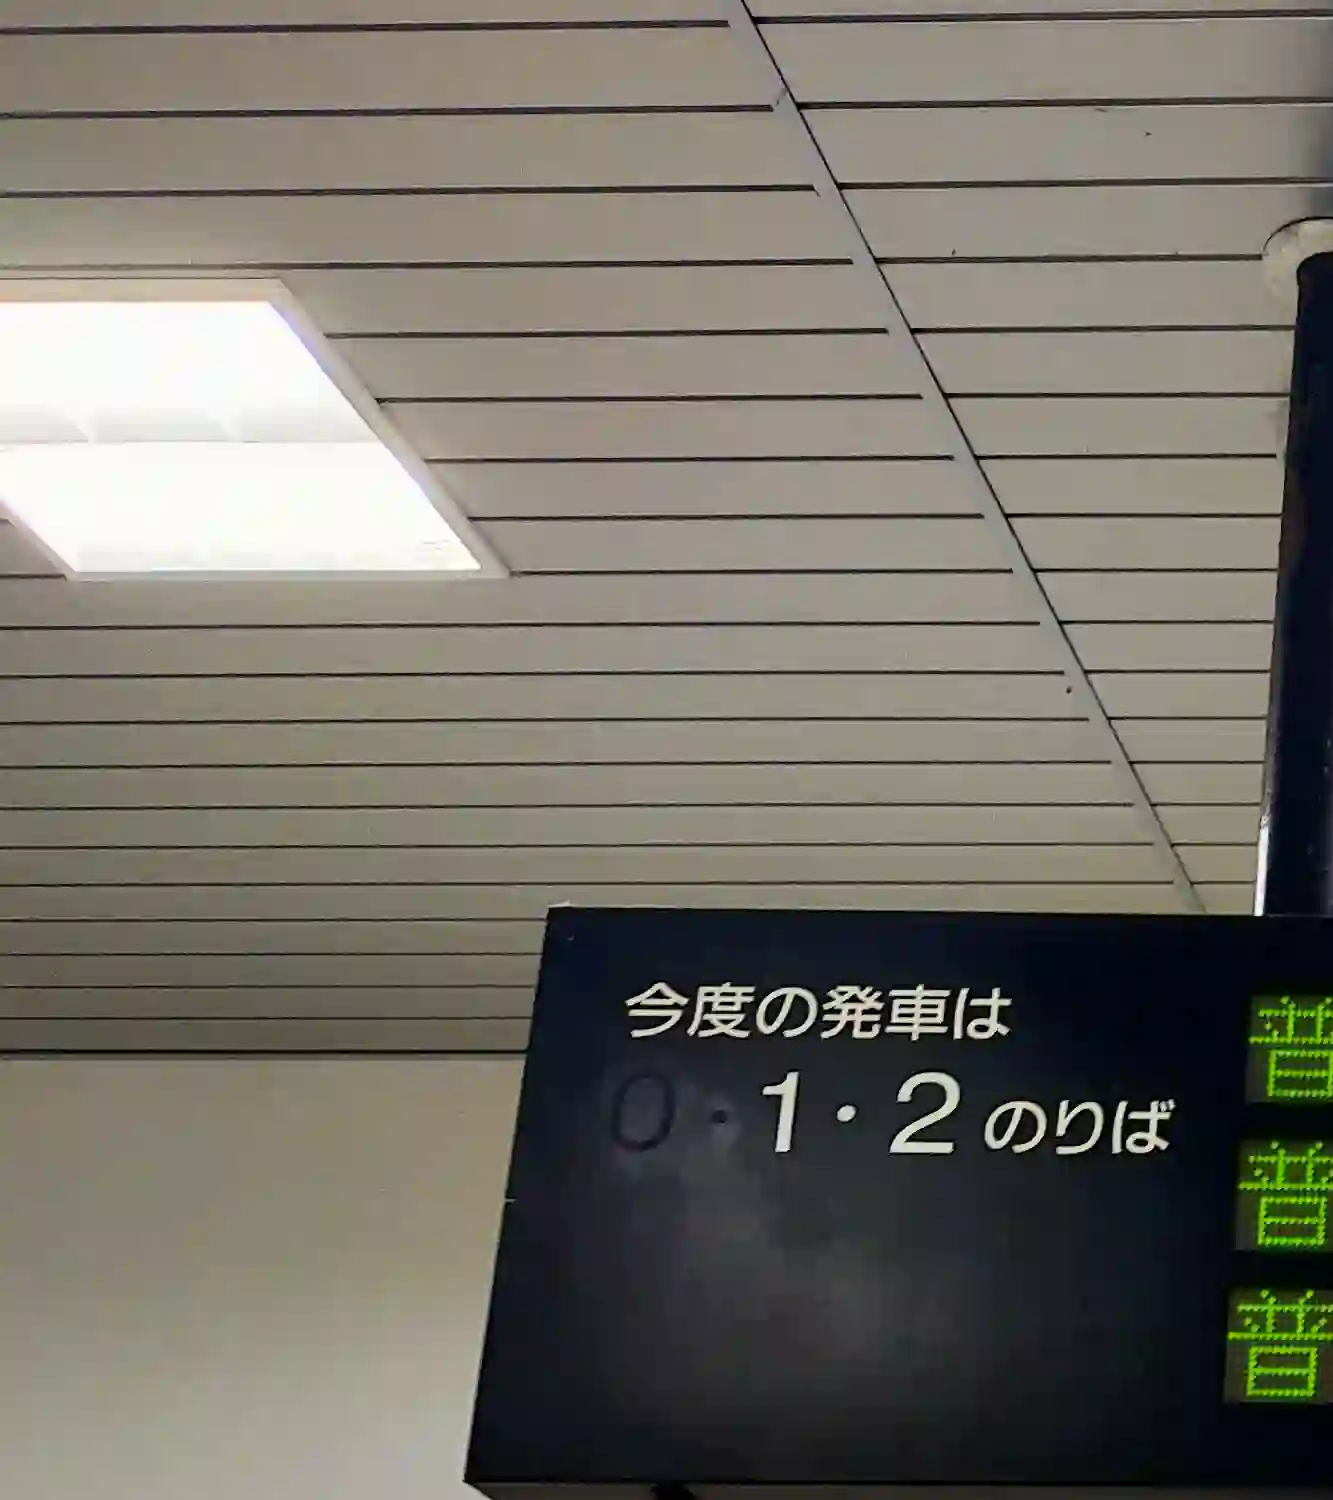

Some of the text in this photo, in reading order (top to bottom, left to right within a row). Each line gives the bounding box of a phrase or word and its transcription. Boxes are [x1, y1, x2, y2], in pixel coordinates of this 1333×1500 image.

[624, 981, 1012, 1040] 今度の発車は
